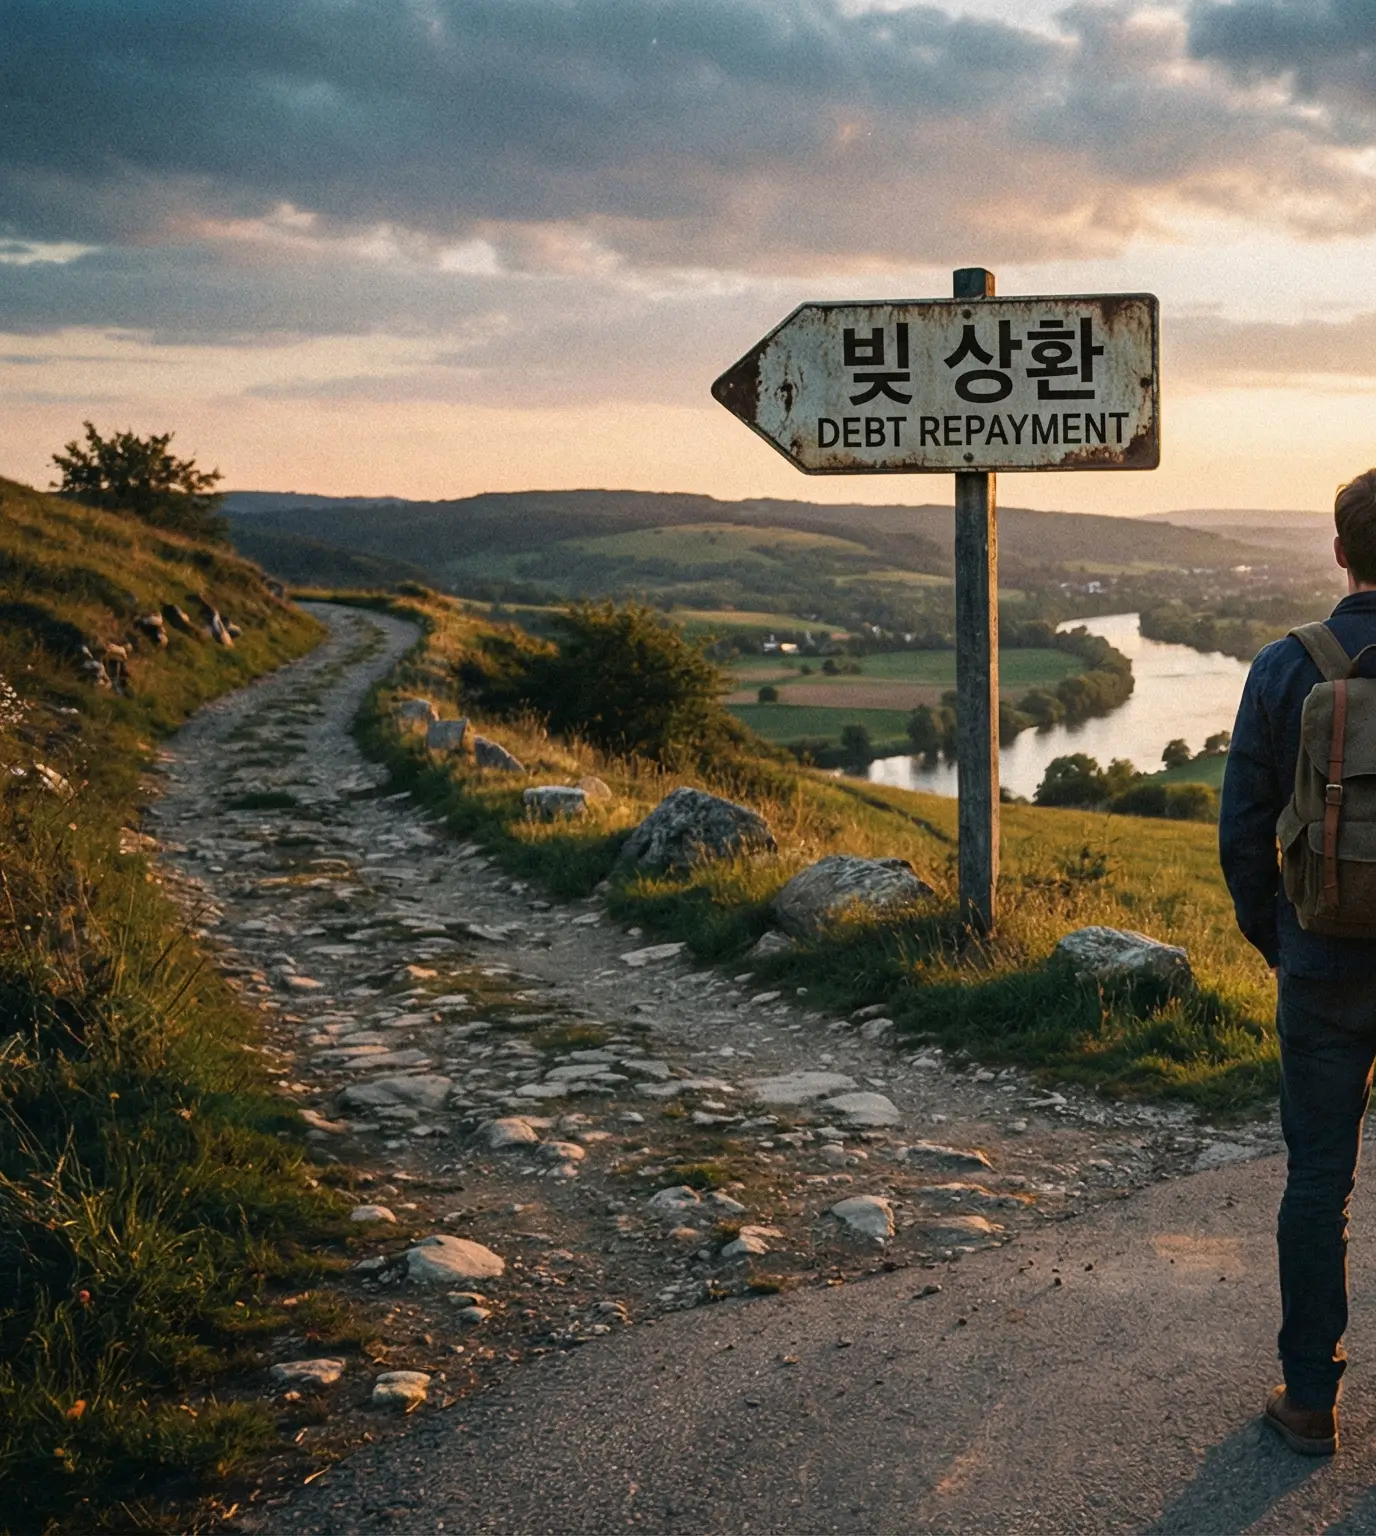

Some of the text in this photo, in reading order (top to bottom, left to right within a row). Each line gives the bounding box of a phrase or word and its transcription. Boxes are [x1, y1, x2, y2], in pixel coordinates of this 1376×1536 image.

[843, 317, 1104, 406] 빚 상환
[817, 412, 1130, 448] DEBT REPAYMENT
